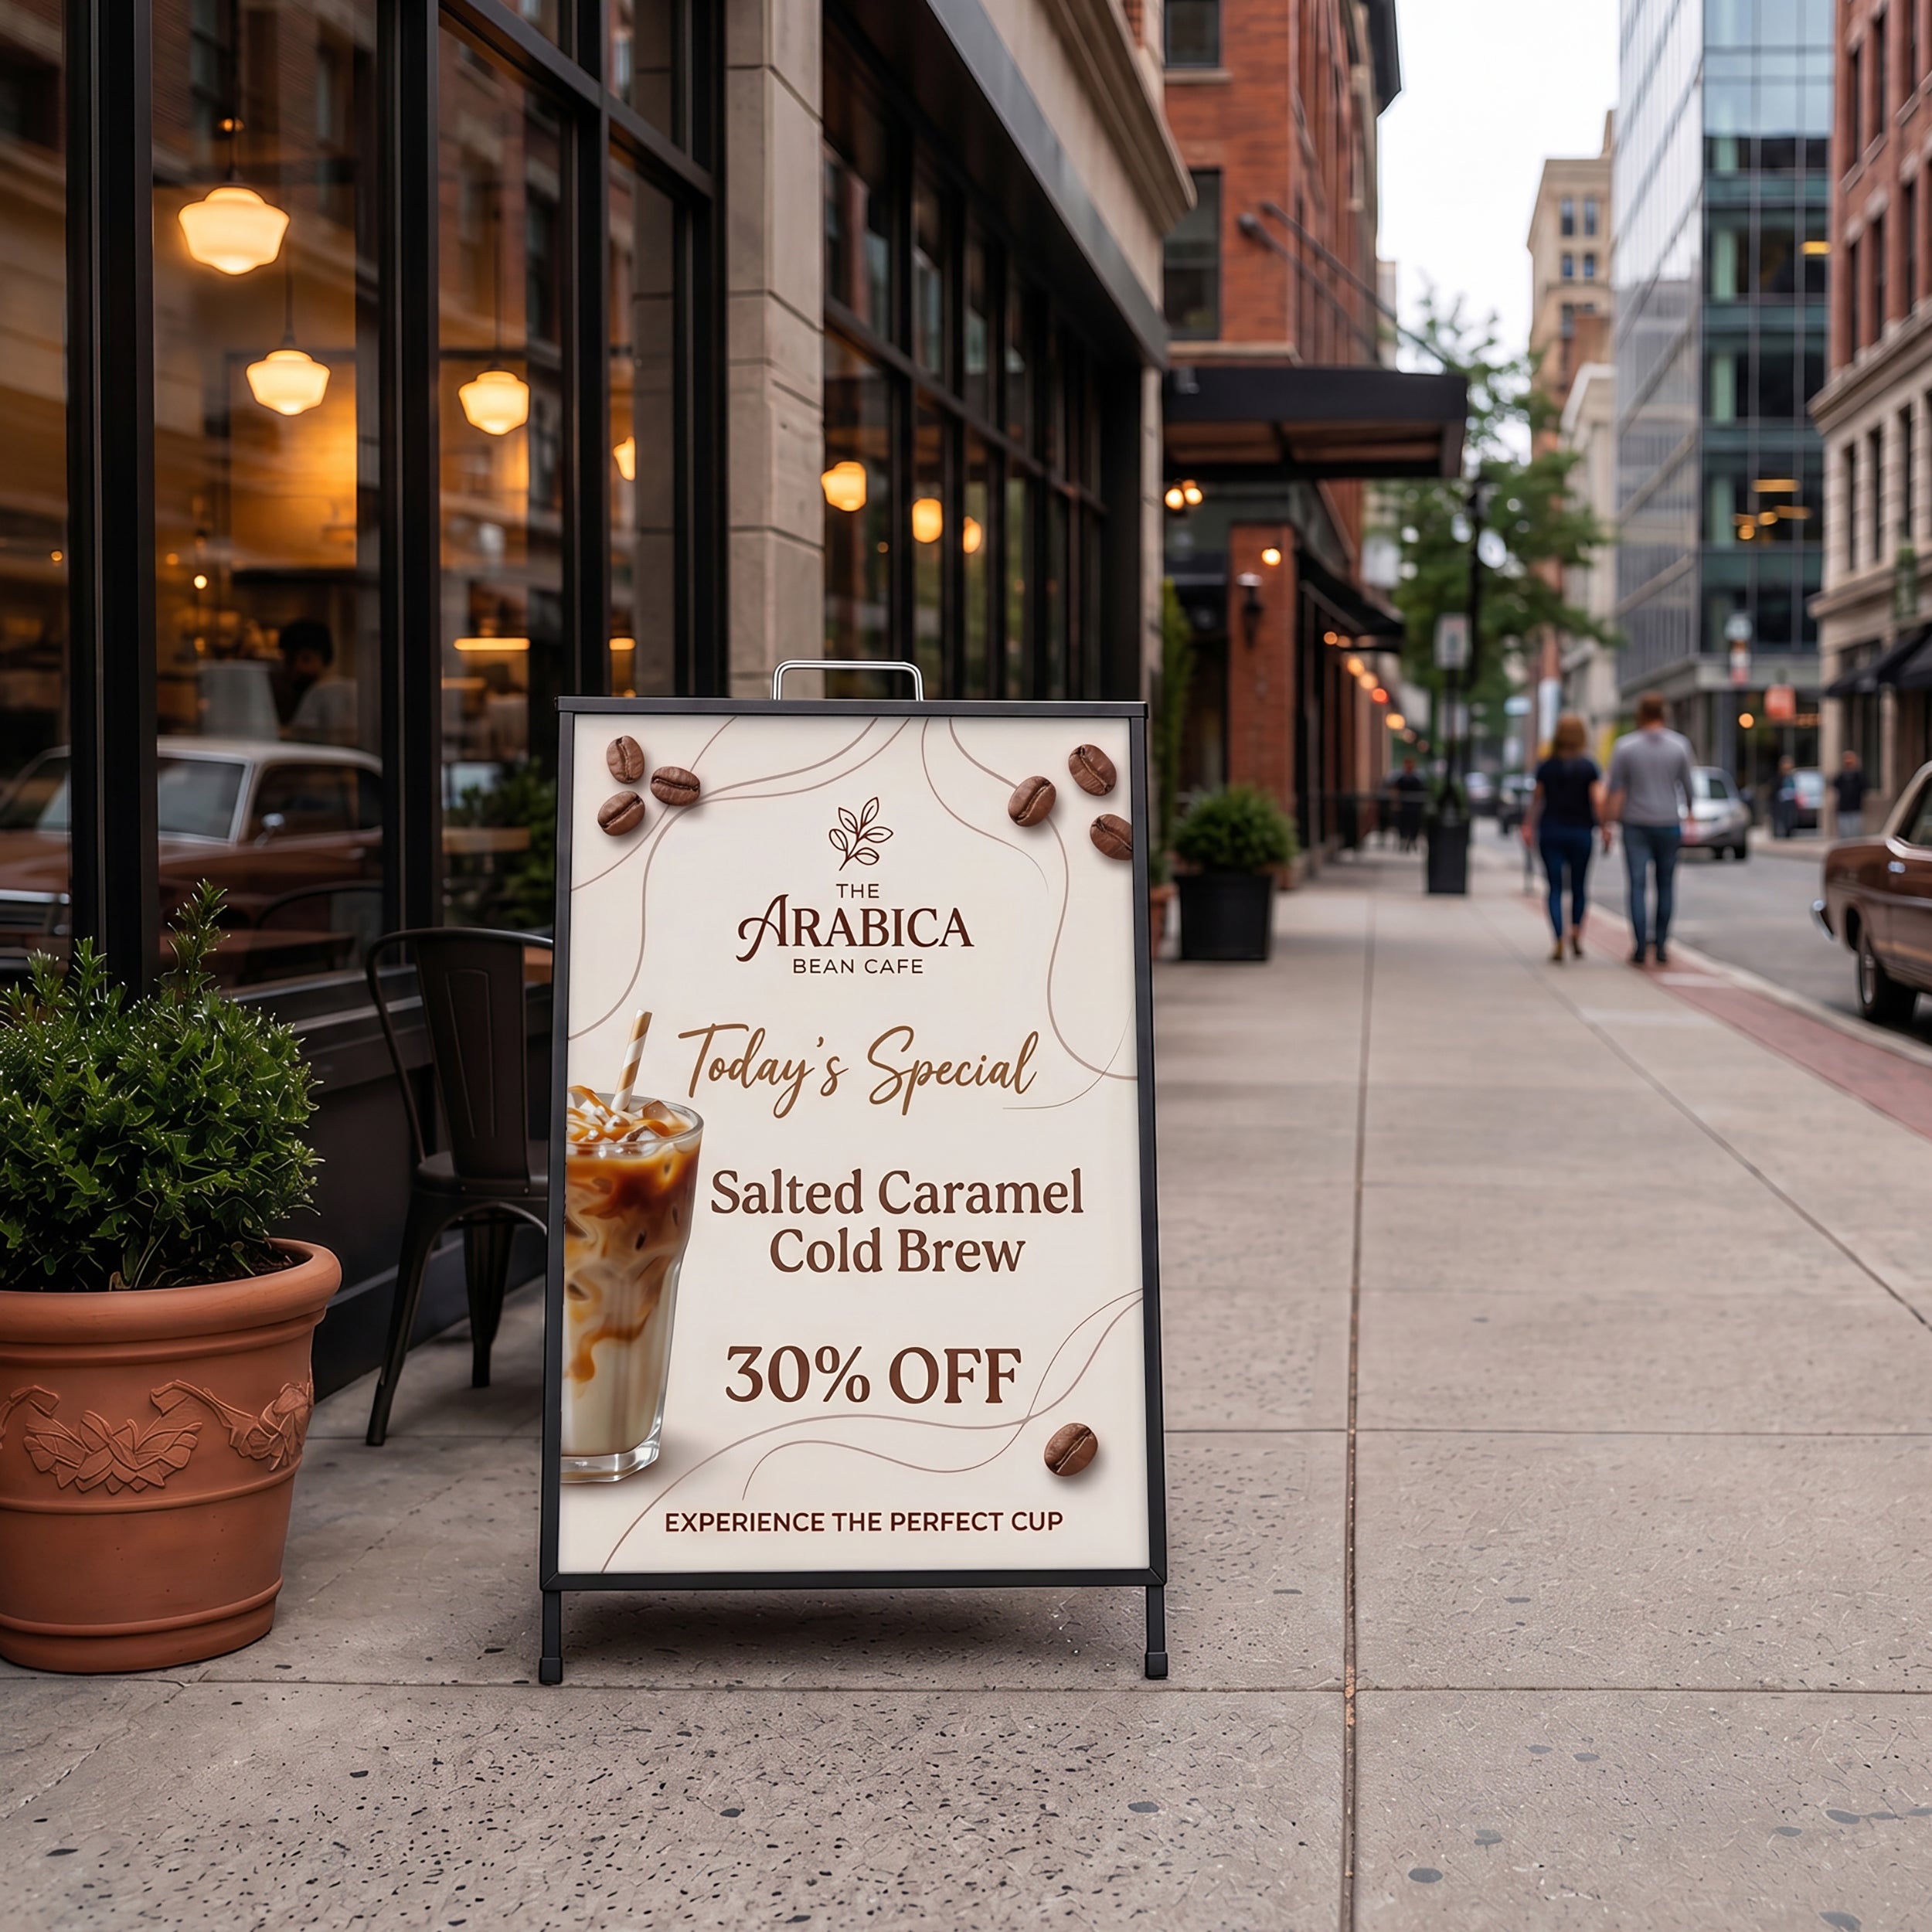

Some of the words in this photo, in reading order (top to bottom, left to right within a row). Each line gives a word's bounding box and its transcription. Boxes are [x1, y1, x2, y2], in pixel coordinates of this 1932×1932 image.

[835, 883, 880, 899] THE
[735, 893, 975, 963] ARABICA
[793, 958, 855, 975] BEAN
[864, 958, 923, 975] CAFE
[678, 1022, 849, 1119] Today's
[868, 1025, 1039, 1117] Special
[710, 1168, 864, 1215] Salted
[878, 1167, 1084, 1215] Caramel
[770, 1226, 883, 1274] Cold
[897, 1228, 1026, 1273] Brew
[725, 1345, 871, 1403] 30%
[889, 1346, 1022, 1405] OFF
[665, 1512, 825, 1532] EXPERIENCE
[831, 1512, 883, 1532] THE
[890, 1511, 1005, 1532] PERFECT
[1011, 1511, 1063, 1532] CUP
